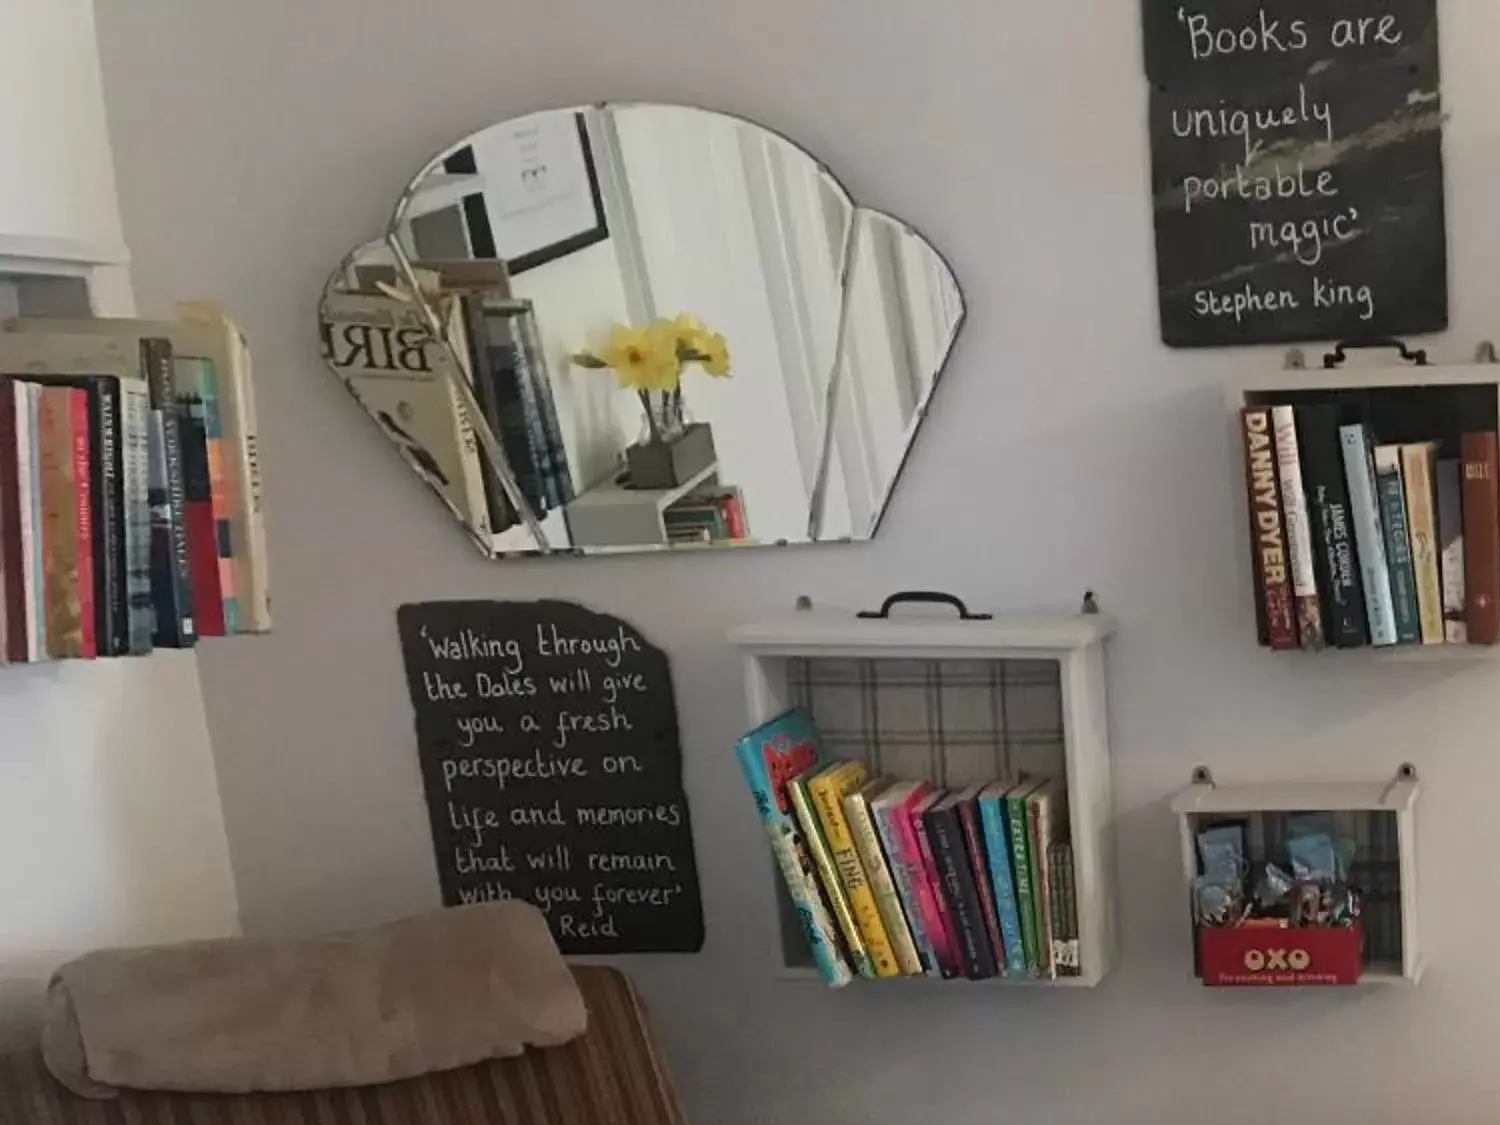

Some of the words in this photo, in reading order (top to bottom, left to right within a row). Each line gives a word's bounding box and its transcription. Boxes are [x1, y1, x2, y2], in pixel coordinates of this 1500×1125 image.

[1331, 14, 1402, 47] are
[1172, 81, 1333, 166] uniquely
[1183, 160, 1339, 214] portable
[1194, 281, 1300, 321] Stephen
[102, 394, 115, 479] WAINWRIGHT
[164, 420, 185, 519] YORKSHIRE
[1246, 411, 1275, 510] DANNY
[1330, 504, 1346, 540] JAMES
[174, 525, 188, 578] DALES
[1257, 510, 1285, 585] DYER
[538, 623, 641, 668] through
[423, 671, 468, 701] the
[476, 672, 538, 699] Dales
[549, 667, 591, 694] will
[603, 671, 648, 703] give
[457, 717, 503, 747] you
[520, 714, 541, 732] a
[555, 707, 633, 749] fresh
[442, 748, 589, 792] perspective
[602, 755, 644, 773] on
[510, 800, 567, 826] and
[577, 802, 681, 826] memories
[455, 847, 516, 874] that
[526, 845, 571, 871] will
[589, 850, 676, 872] remain
[1010, 817, 1026, 861] EXTRA
[837, 848, 864, 890] FING
[1016, 864, 1029, 896] TIME
[459, 882, 513, 905] with
[534, 886, 581, 912] you
[560, 915, 620, 939] Reid
[1244, 948, 1311, 971] OXO
